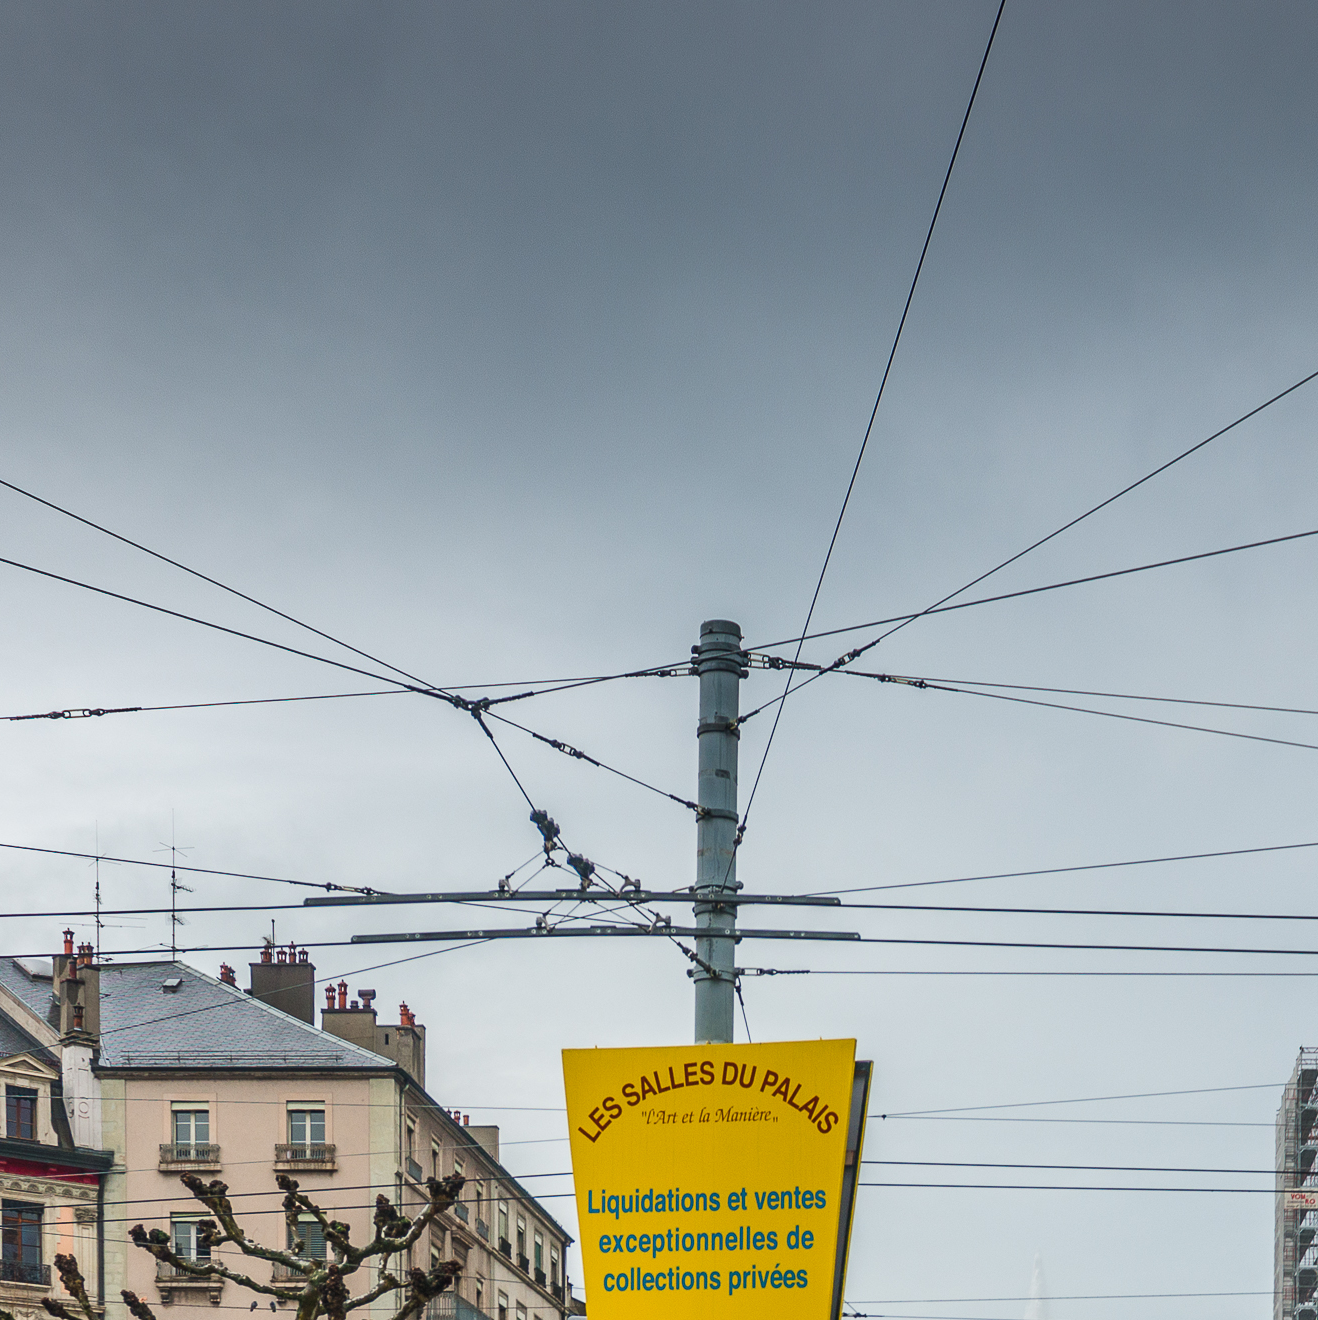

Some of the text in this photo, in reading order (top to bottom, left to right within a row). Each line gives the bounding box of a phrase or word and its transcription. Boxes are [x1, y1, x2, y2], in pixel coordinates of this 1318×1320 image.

[578, 1061, 839, 1143] LES SALLES DU PALAIS
[681, 1111, 694, 1124] et
[698, 1107, 711, 1122] la
[587, 1186, 827, 1220] Liquidations et ventes
[599, 1225, 814, 1259] exceptionnelles de
[603, 1263, 808, 1296] collections privées
